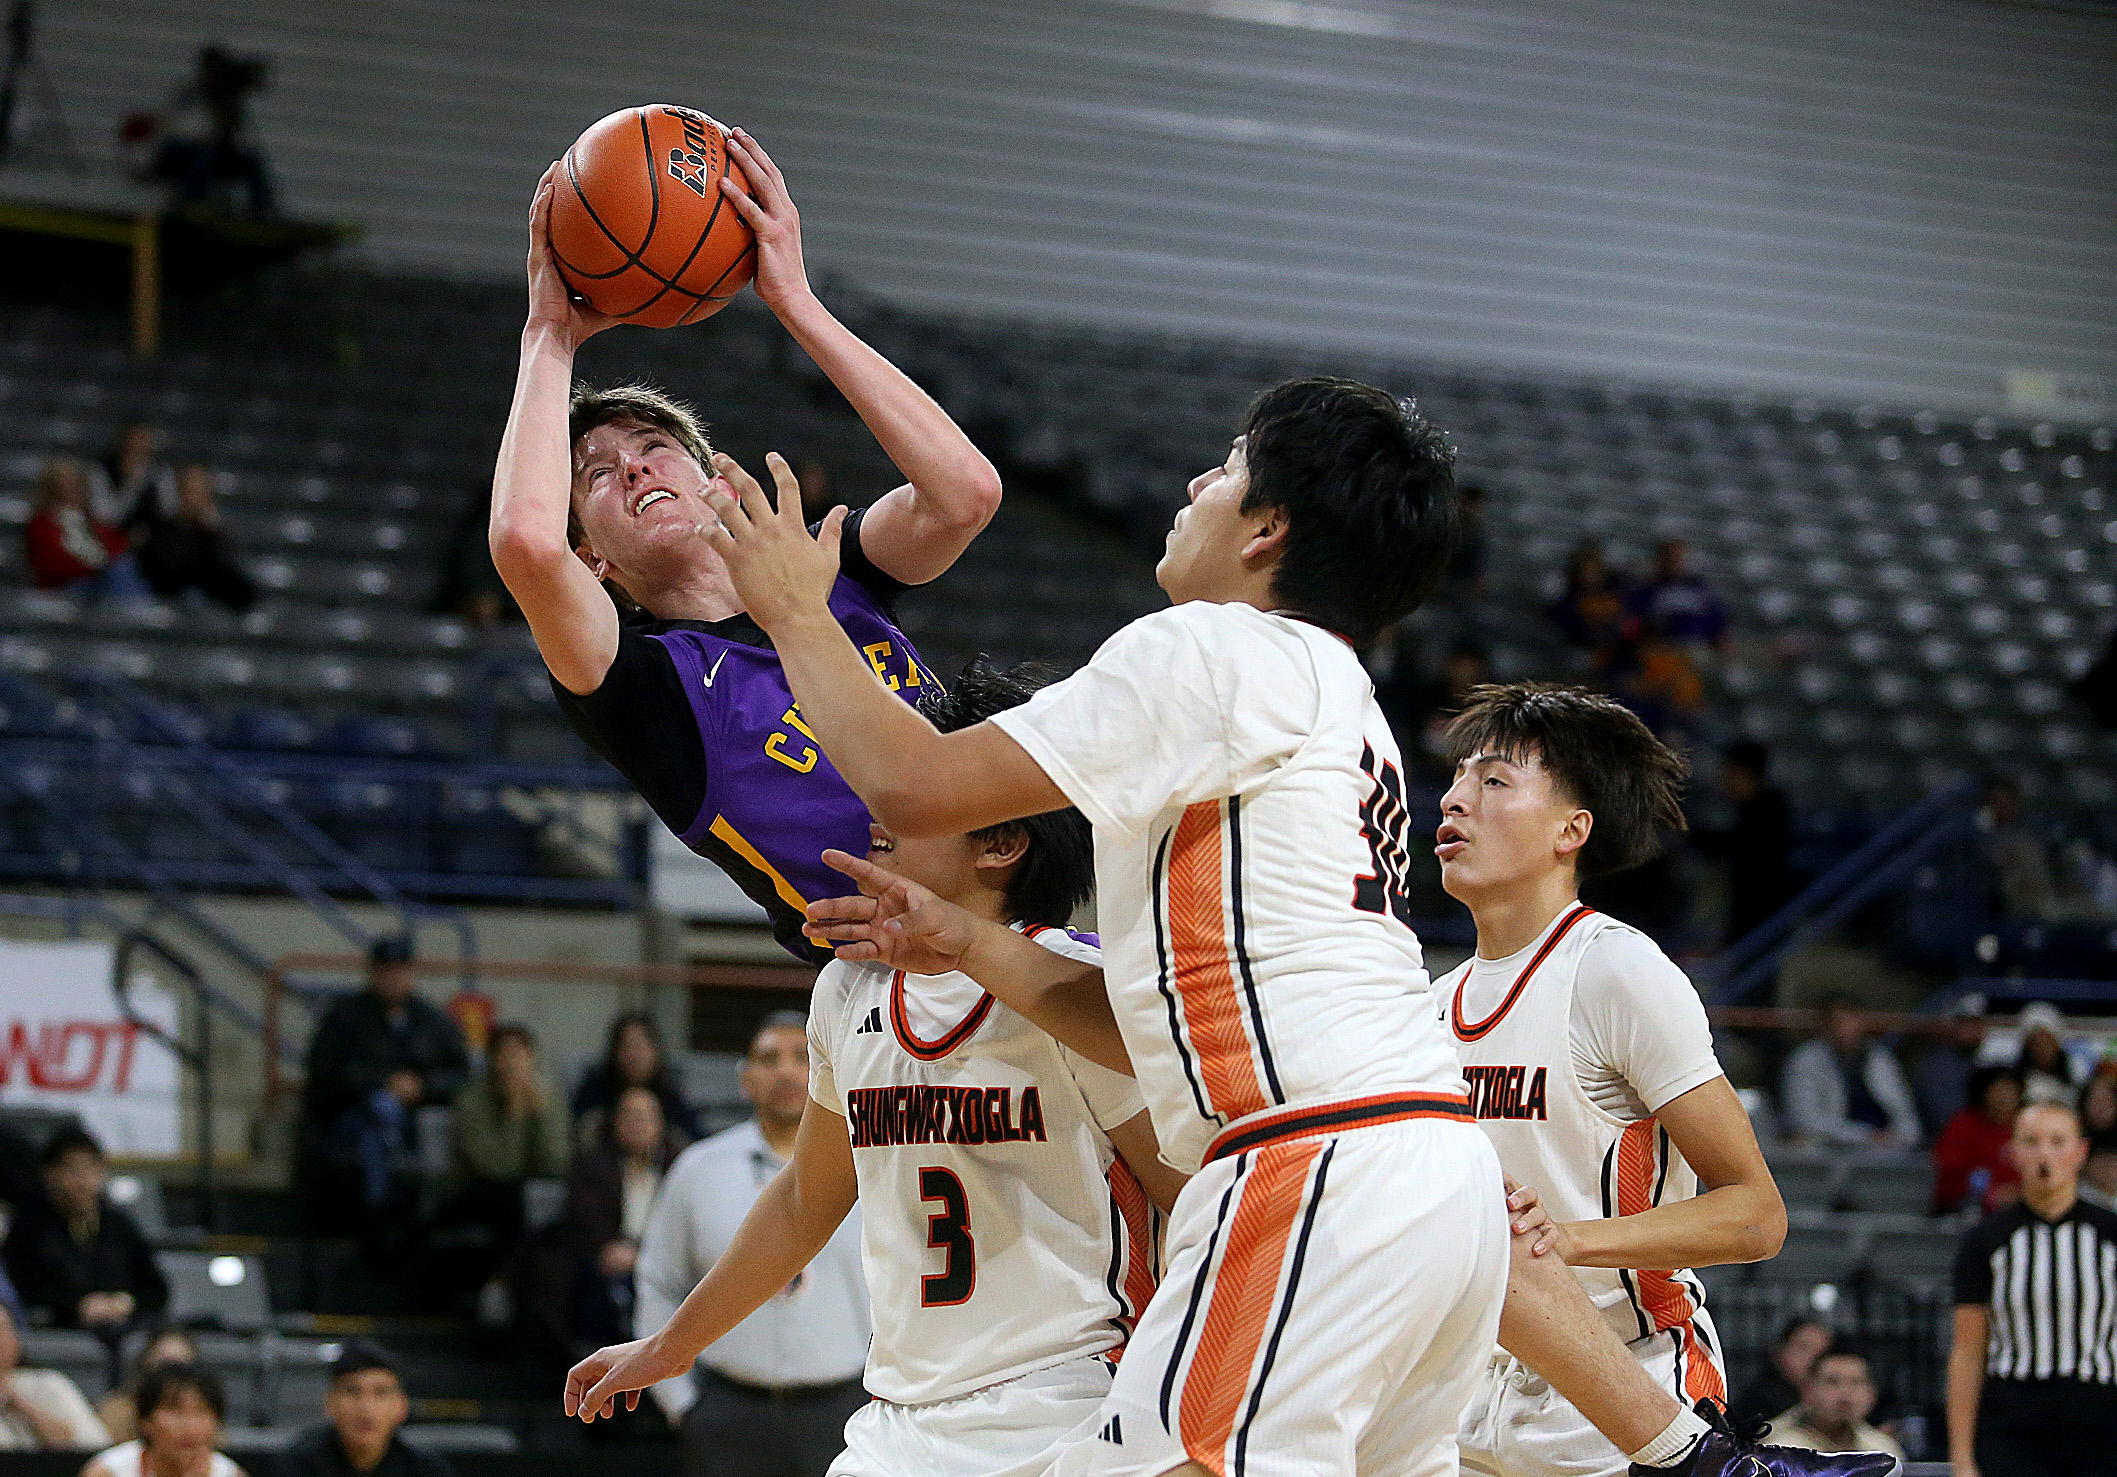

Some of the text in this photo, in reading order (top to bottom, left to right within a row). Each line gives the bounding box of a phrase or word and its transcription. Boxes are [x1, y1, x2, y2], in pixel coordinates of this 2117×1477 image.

[846, 1084, 1048, 1148] SHUNGWATXOGLA
[1462, 1065, 1547, 1121] TXOGLA
[918, 1166, 977, 1308] 3
